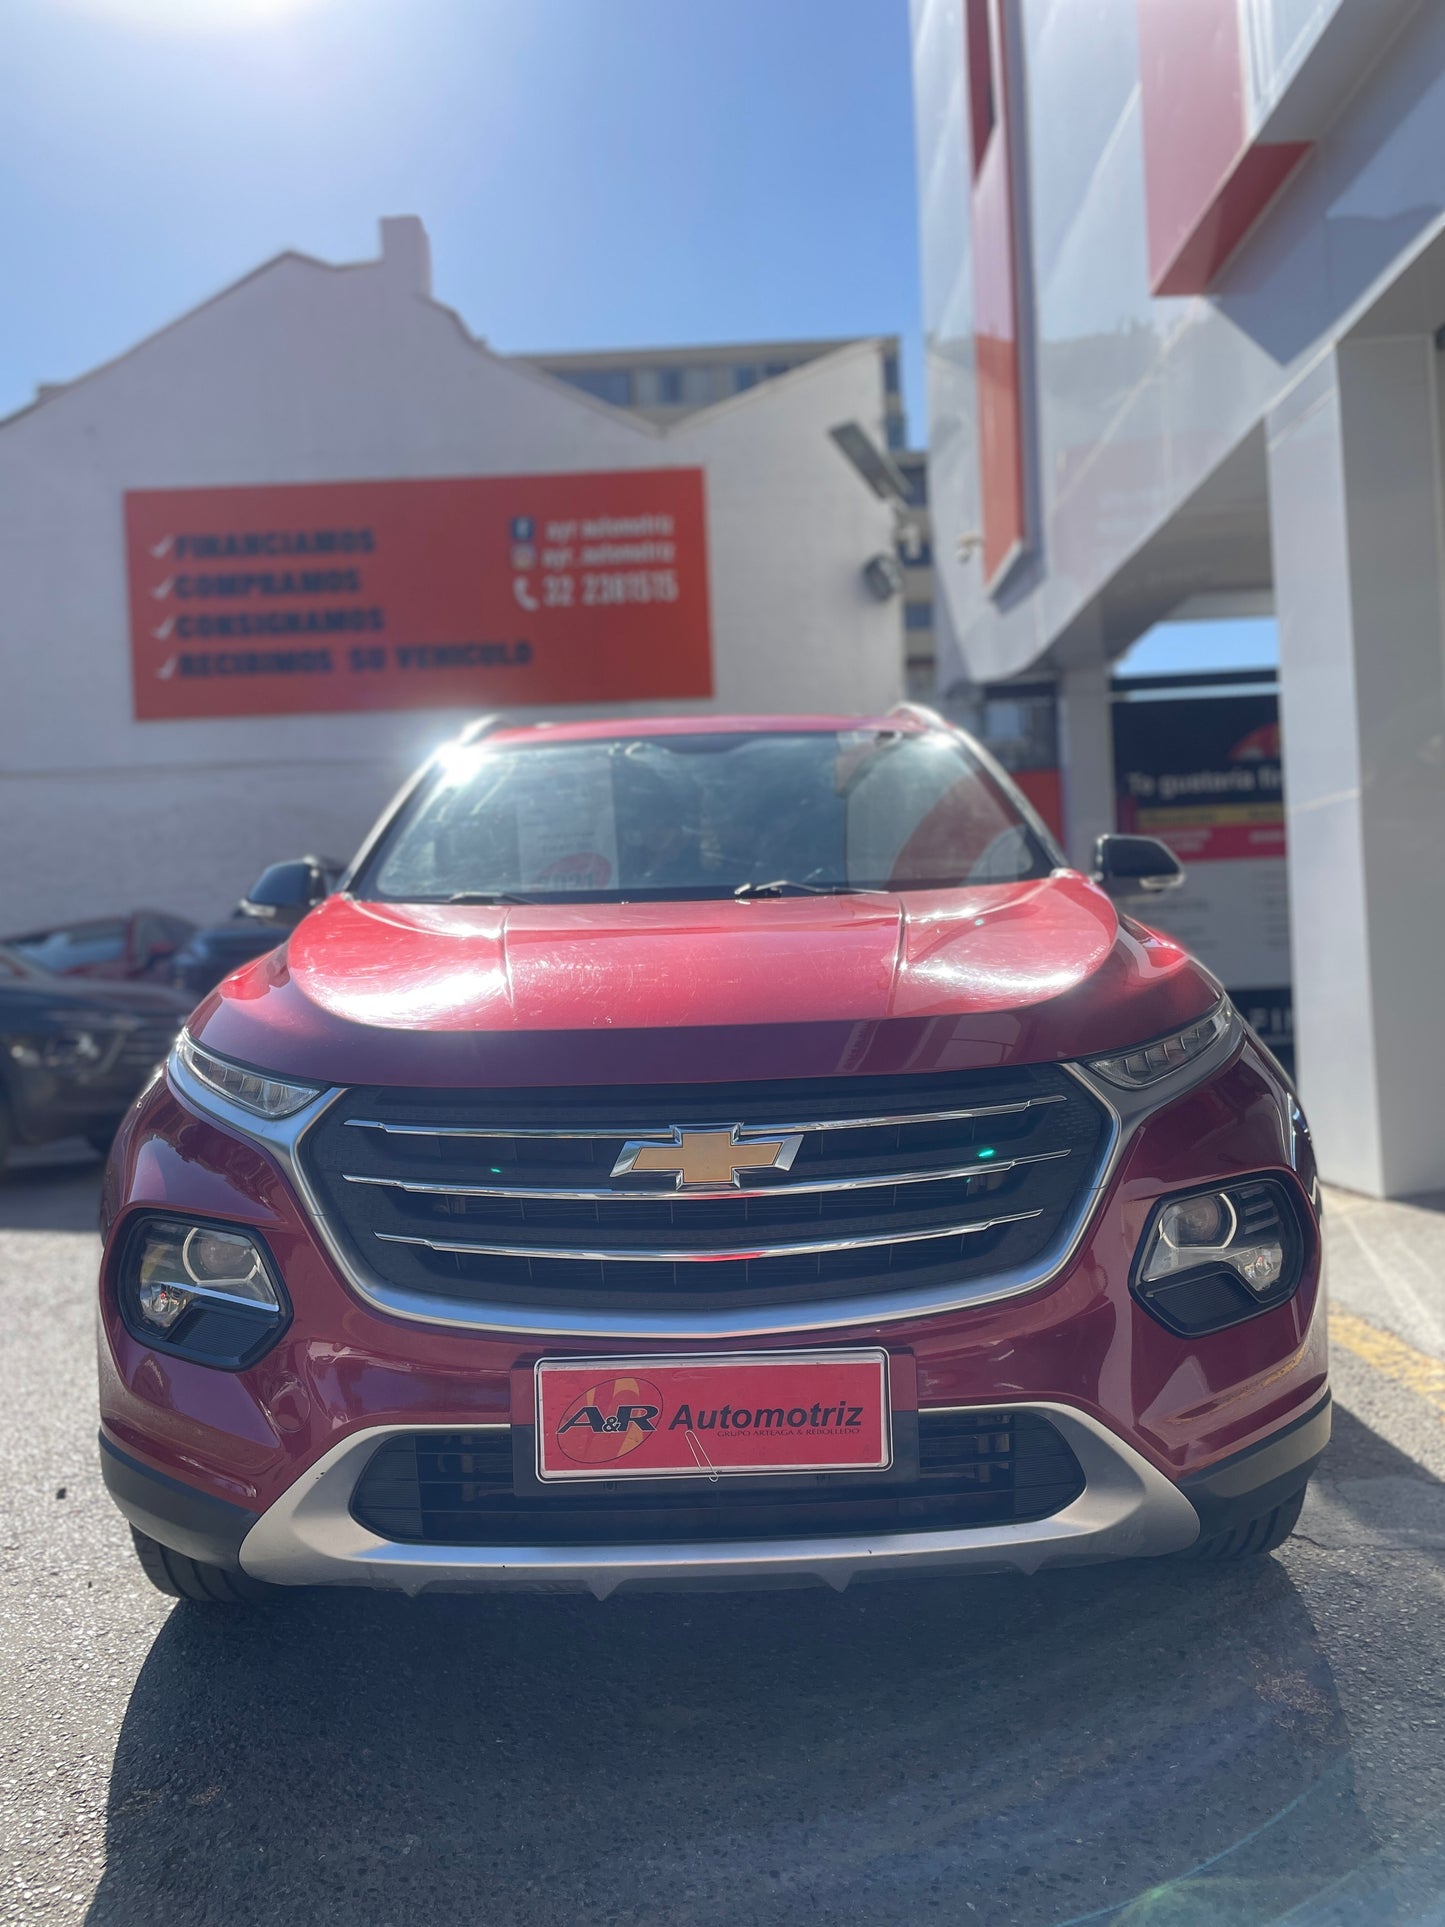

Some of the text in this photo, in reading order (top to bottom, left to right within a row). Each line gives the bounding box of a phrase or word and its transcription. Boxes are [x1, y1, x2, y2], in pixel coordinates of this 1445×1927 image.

[175, 529, 373, 559] FINANCIAMOS
[176, 568, 361, 598] COMPRAMOS
[542, 575, 574, 606] 32
[177, 608, 384, 638] CONSIGNAMOS
[179, 649, 333, 677] RECIBIMOS
[556, 1401, 863, 1435] A&R Automotriz
[754, 1429, 794, 1437] ARTEAGA
[806, 1427, 860, 1436] REBOLLEDO
